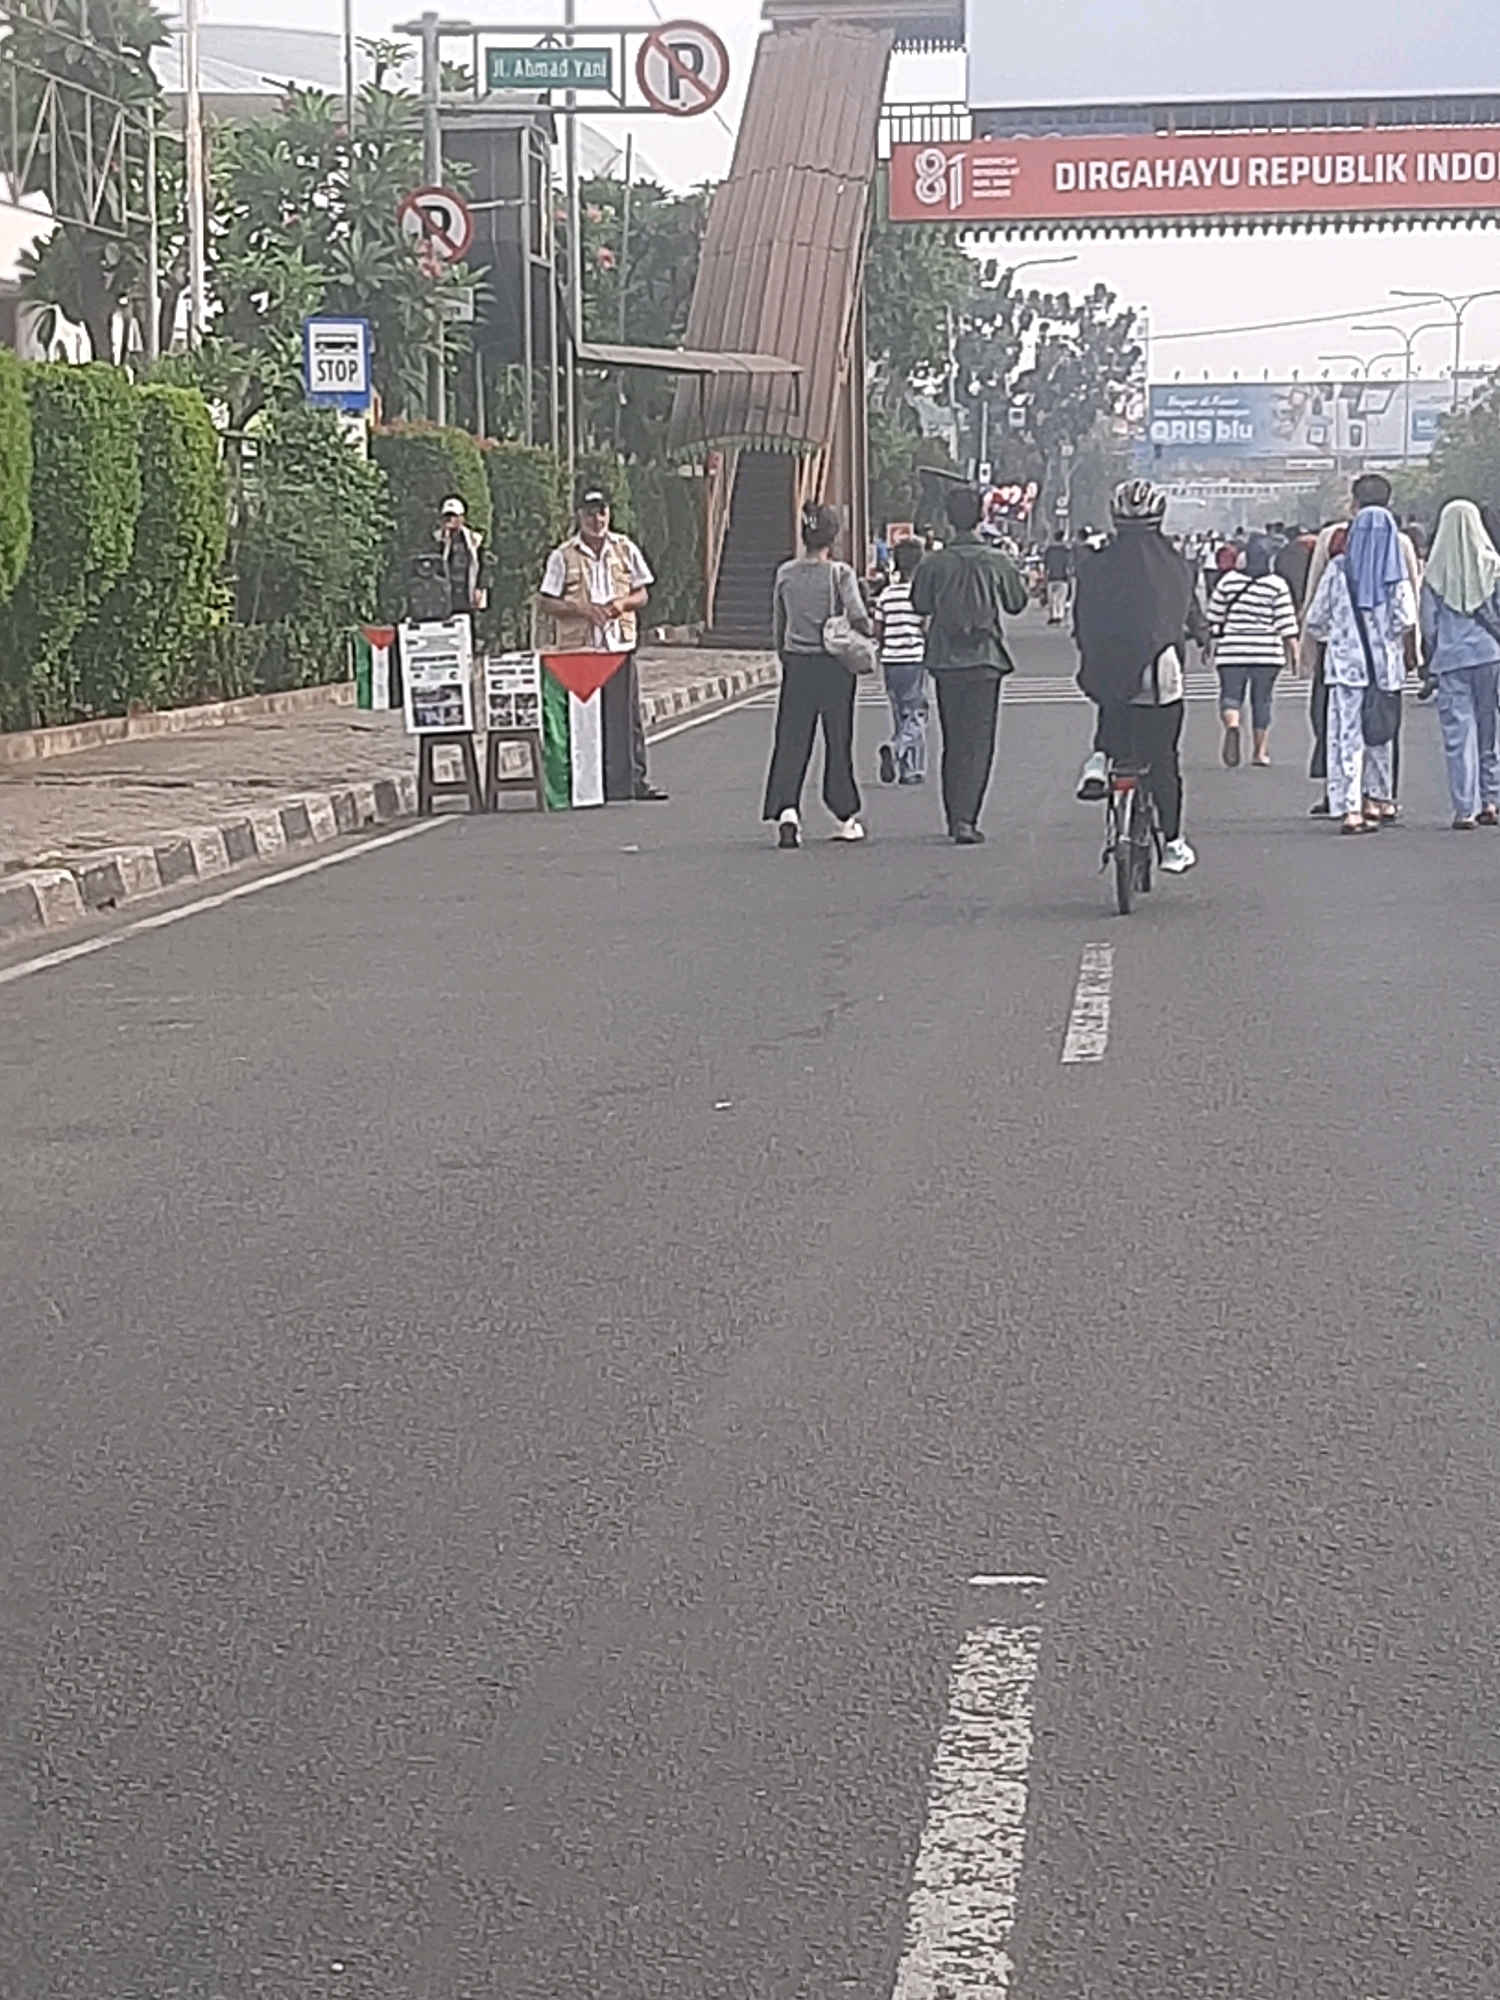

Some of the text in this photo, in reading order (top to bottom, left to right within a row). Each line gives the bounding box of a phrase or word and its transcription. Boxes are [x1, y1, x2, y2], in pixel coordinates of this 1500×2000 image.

[514, 58, 568, 78] Ahmad
[573, 58, 606, 78] Yani
[667, 43, 704, 100] P
[914, 148, 968, 210] 81
[1055, 152, 1500, 191] DIRGAHAYU REPUBLIK INDO
[317, 359, 358, 382] STOP
[1150, 419, 1253, 442] QRIS blu
